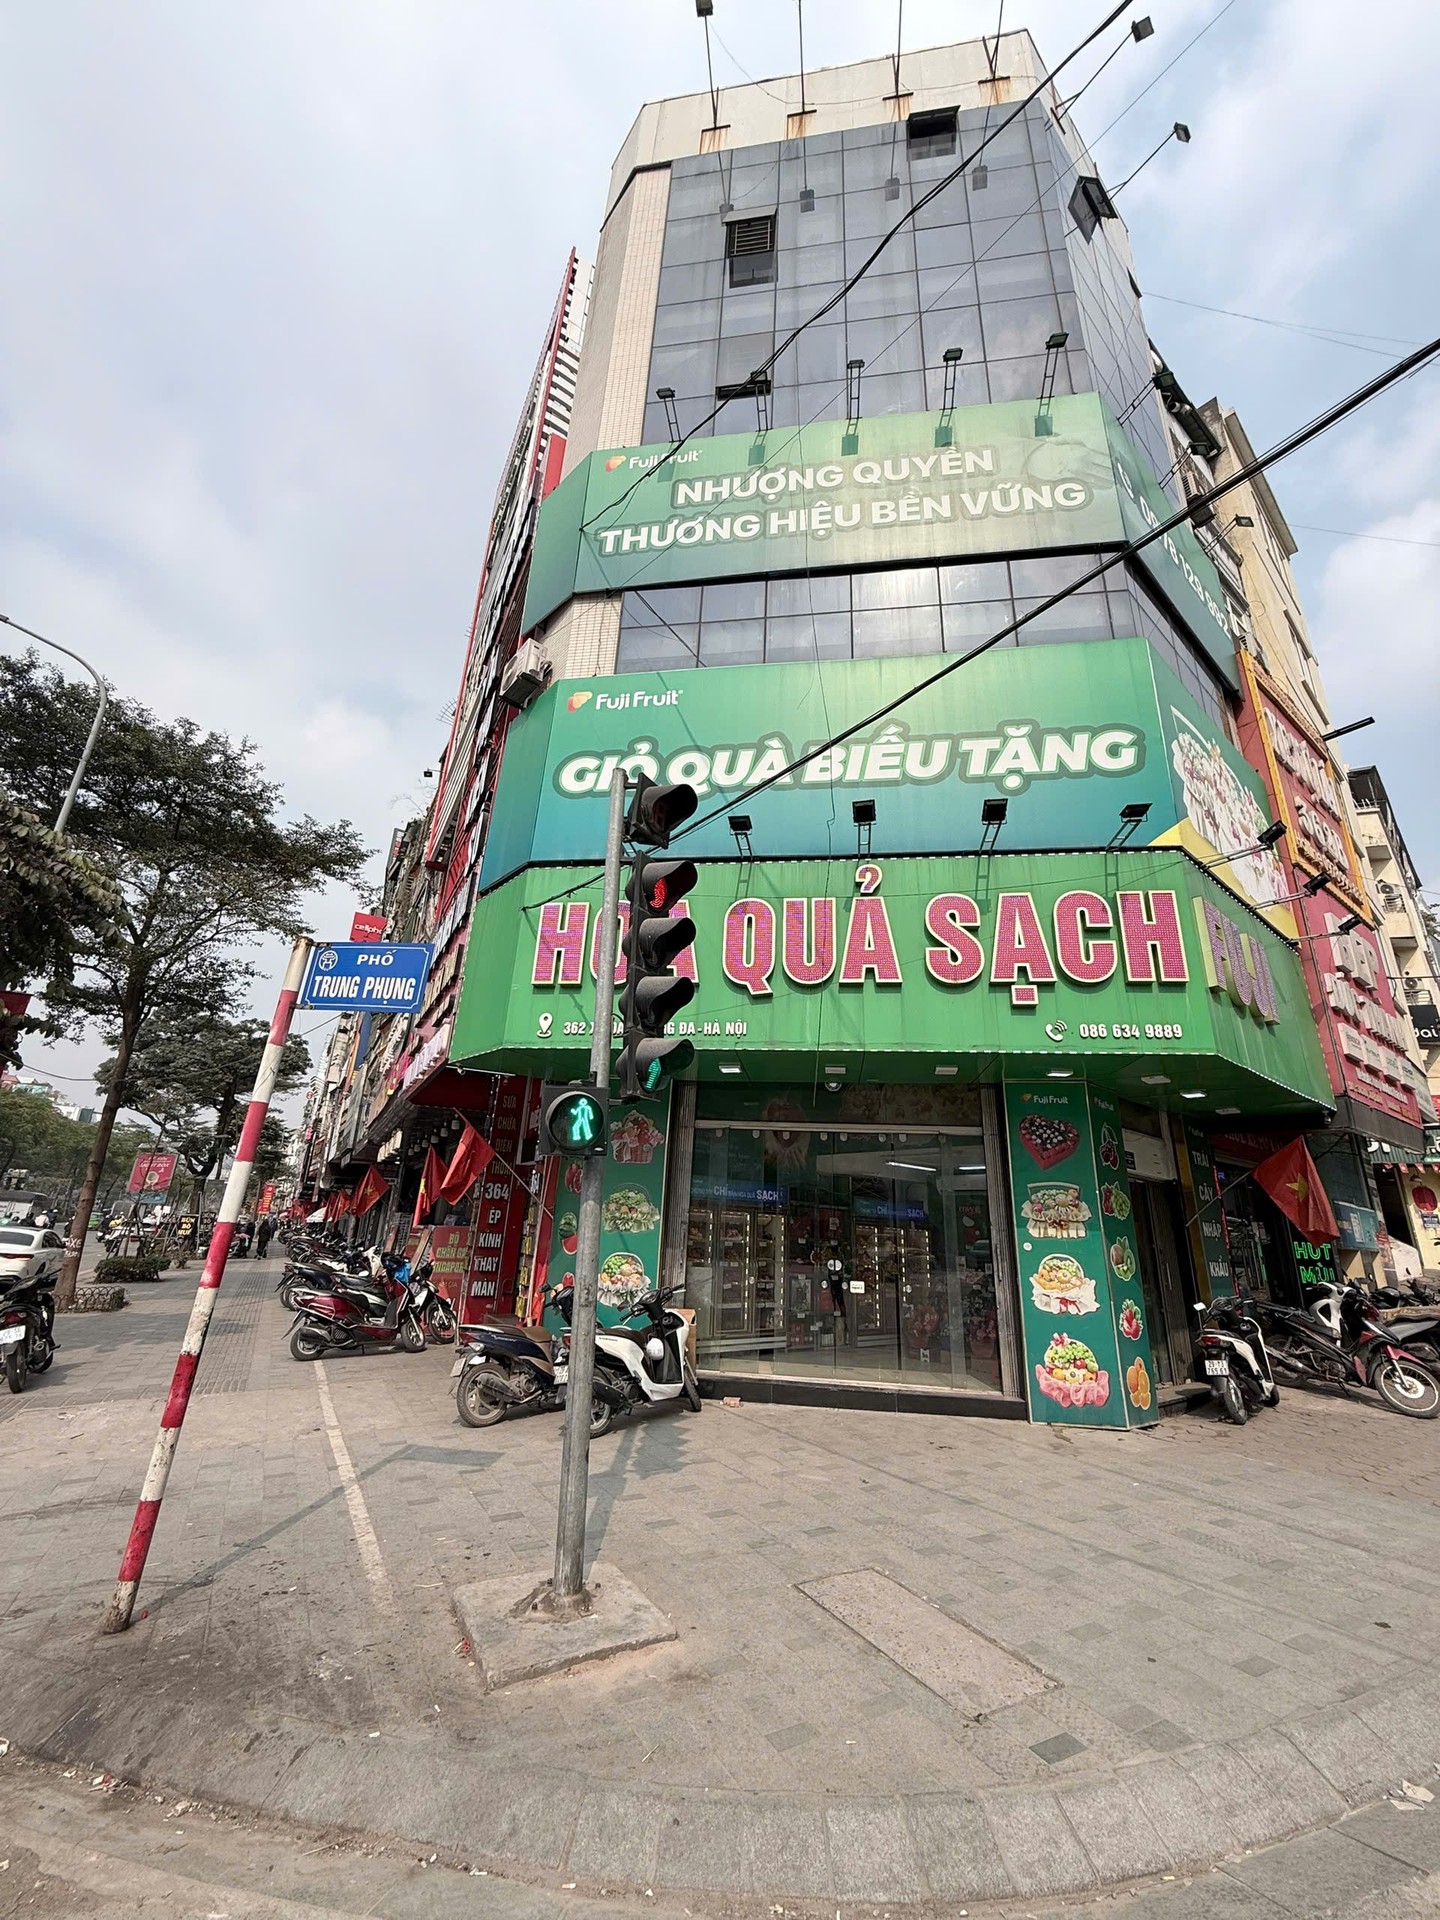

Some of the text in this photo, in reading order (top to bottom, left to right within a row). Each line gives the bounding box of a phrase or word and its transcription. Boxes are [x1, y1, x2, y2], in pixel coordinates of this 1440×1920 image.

[676, 447, 993, 505] NHƯỢNG QUYỀN
[600, 482, 1086, 553] THƯƠNG HIỆU BỀN VỮNG
[595, 690, 679, 711] Fuji Fruit
[559, 724, 1138, 796] GIỎ QUÀ BIẾU TẶNG
[722, 864, 903, 996] QUẢ
[925, 890, 1189, 1006] SẠCH
[357, 949, 397, 966] PHỐ
[312, 975, 416, 1005] TRUNG PHỤNG
[563, 1021, 586, 1035] 362
[726, 1019, 747, 1038] NỘI
[1079, 1023, 1183, 1038] 086 634 9889
[485, 1182, 509, 1200] 364
[1198, 1183, 1214, 1201] CÂY
[1202, 1219, 1222, 1242] NHẬP
[474, 1256, 498, 1272] THAY
[1209, 1255, 1229, 1277] KHẨU
[1299, 1262, 1335, 1284] MÙI
